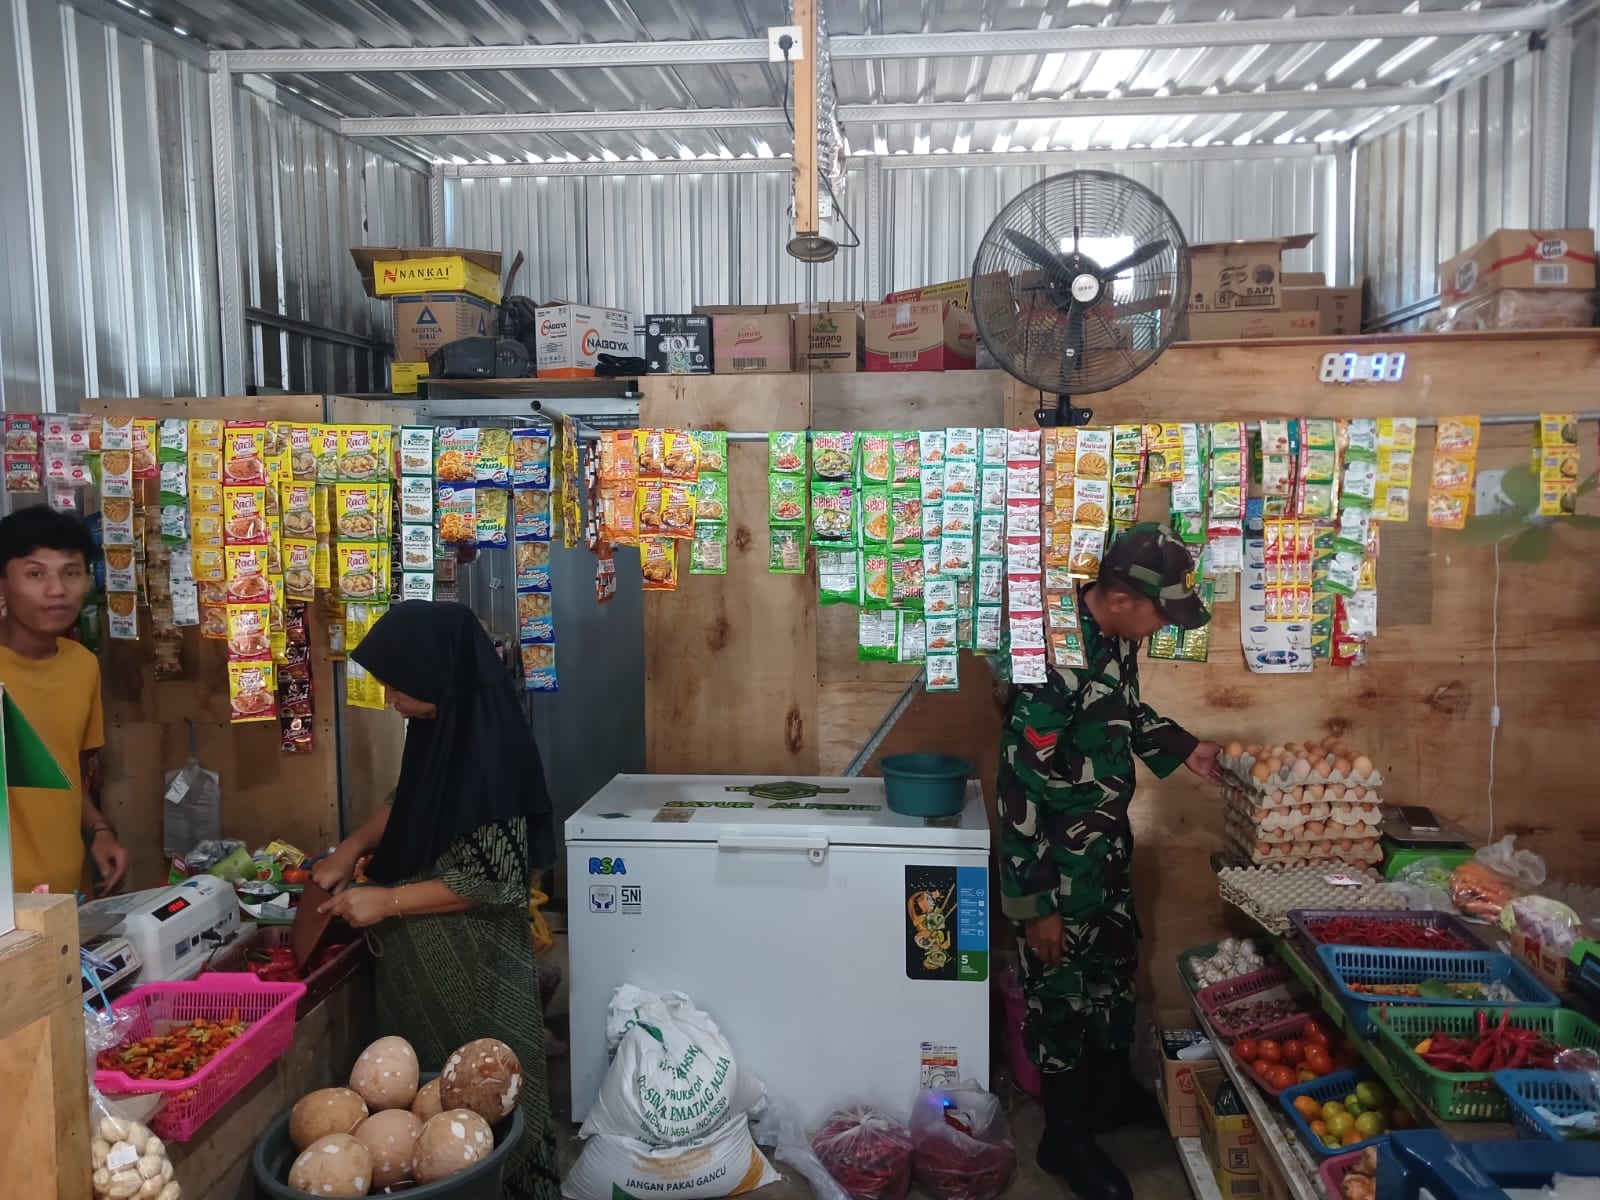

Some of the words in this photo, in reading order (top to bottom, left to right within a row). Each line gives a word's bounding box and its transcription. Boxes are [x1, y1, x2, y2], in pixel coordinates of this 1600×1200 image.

[399, 267, 449, 279] NANKAI
[543, 321, 567, 330] NAGOYA
[586, 338, 629, 352] NAGOYA
[658, 335, 700, 353] TOP
[232, 438, 256, 451] Racik
[345, 436, 371, 448] Racik
[232, 498, 256, 510] Racik
[345, 496, 370, 507] Racik
[234, 555, 259, 568] Racik
[346, 553, 370, 566] Racik
[588, 856, 627, 875] RSA
[621, 888, 641, 902] SNI
[961, 954, 969, 964] 5
[1234, 1153, 1244, 1164] 5
[625, 1178, 664, 1192] JANGAN
[666, 1179, 695, 1191] PAKAI
[696, 1165, 727, 1186] GANCU
